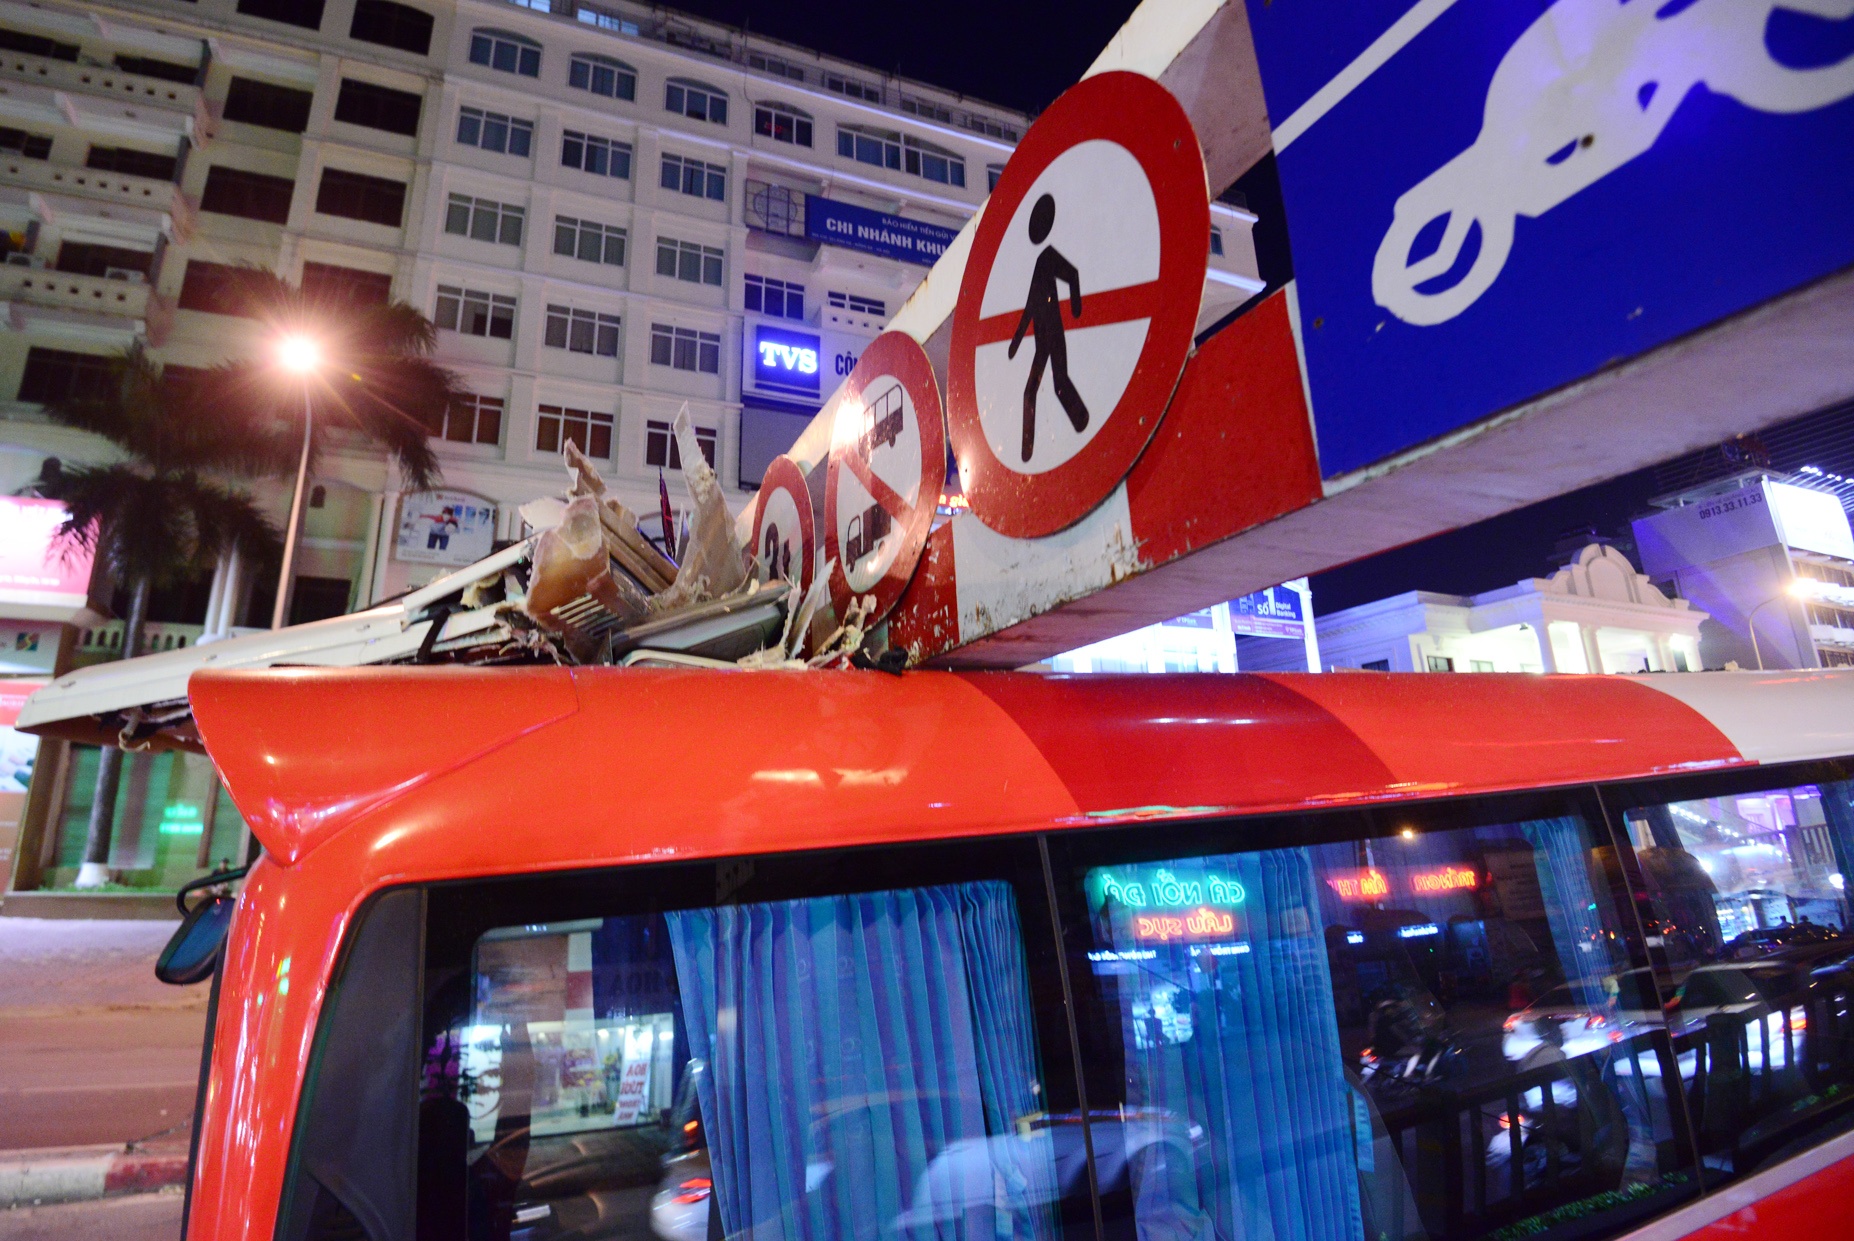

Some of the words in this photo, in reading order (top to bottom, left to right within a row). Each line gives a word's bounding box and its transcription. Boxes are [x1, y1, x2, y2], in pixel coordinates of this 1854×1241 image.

[826, 217, 853, 235] CHI
[759, 341, 818, 374] TVS
[835, 350, 858, 376] CÔ
